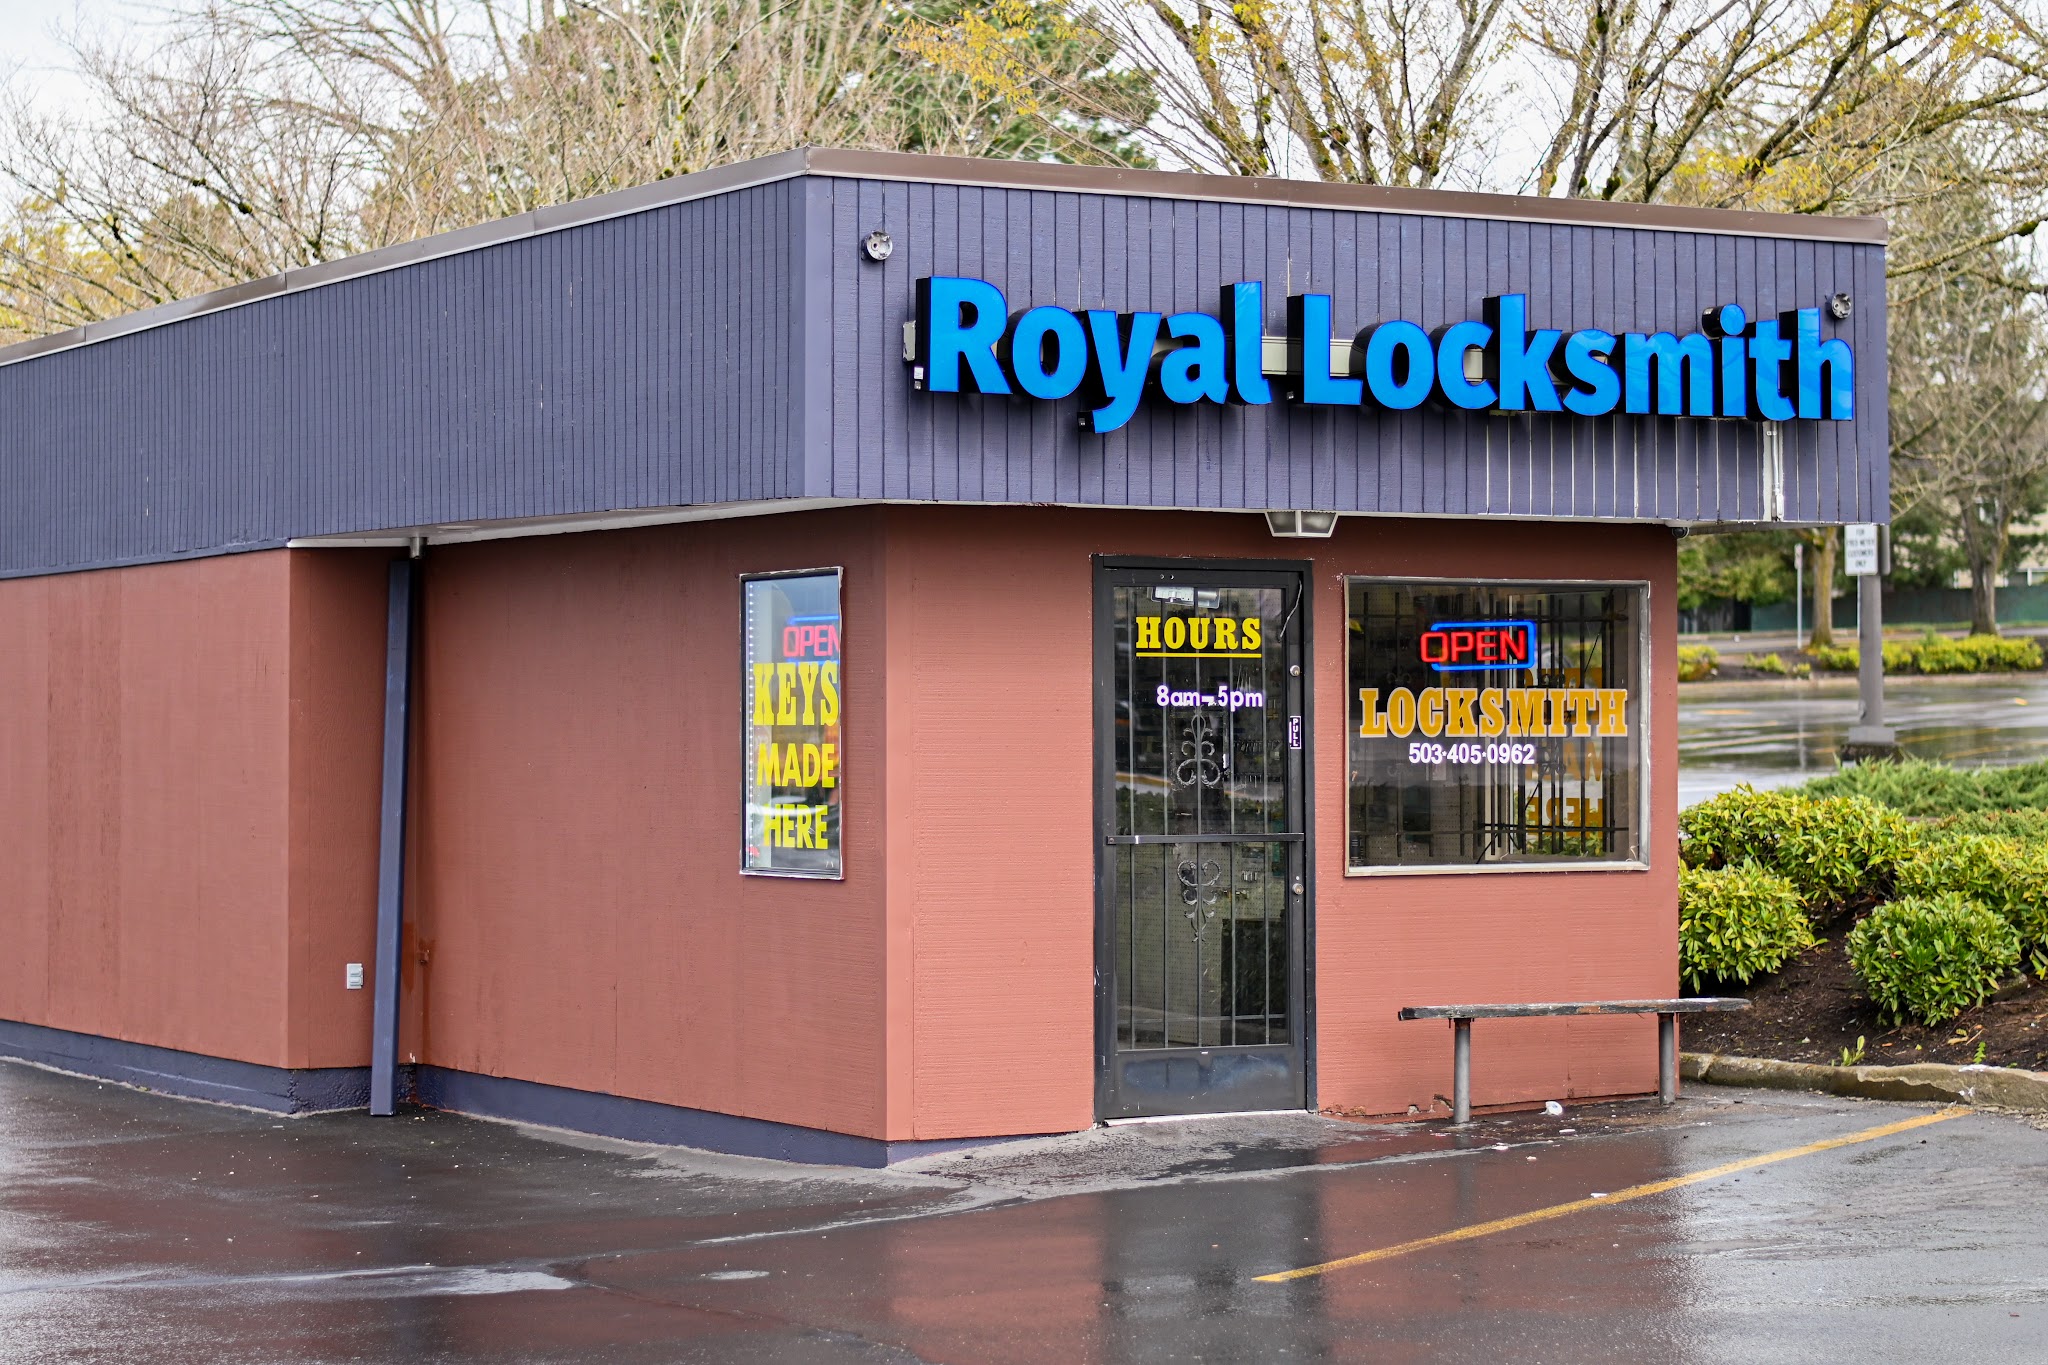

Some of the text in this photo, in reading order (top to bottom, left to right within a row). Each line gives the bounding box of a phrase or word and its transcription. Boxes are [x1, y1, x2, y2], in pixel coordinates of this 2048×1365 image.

[928, 276, 1854, 434] Royal Locksmith
[783, 625, 839, 657] OPEN
[1135, 616, 1262, 650] HOURS
[1420, 630, 1526, 663] OPEN
[753, 660, 839, 727] KEYS
[1359, 686, 1628, 738] LOCKSMITH
[756, 743, 835, 788] MADE
[763, 803, 829, 850] HERE
